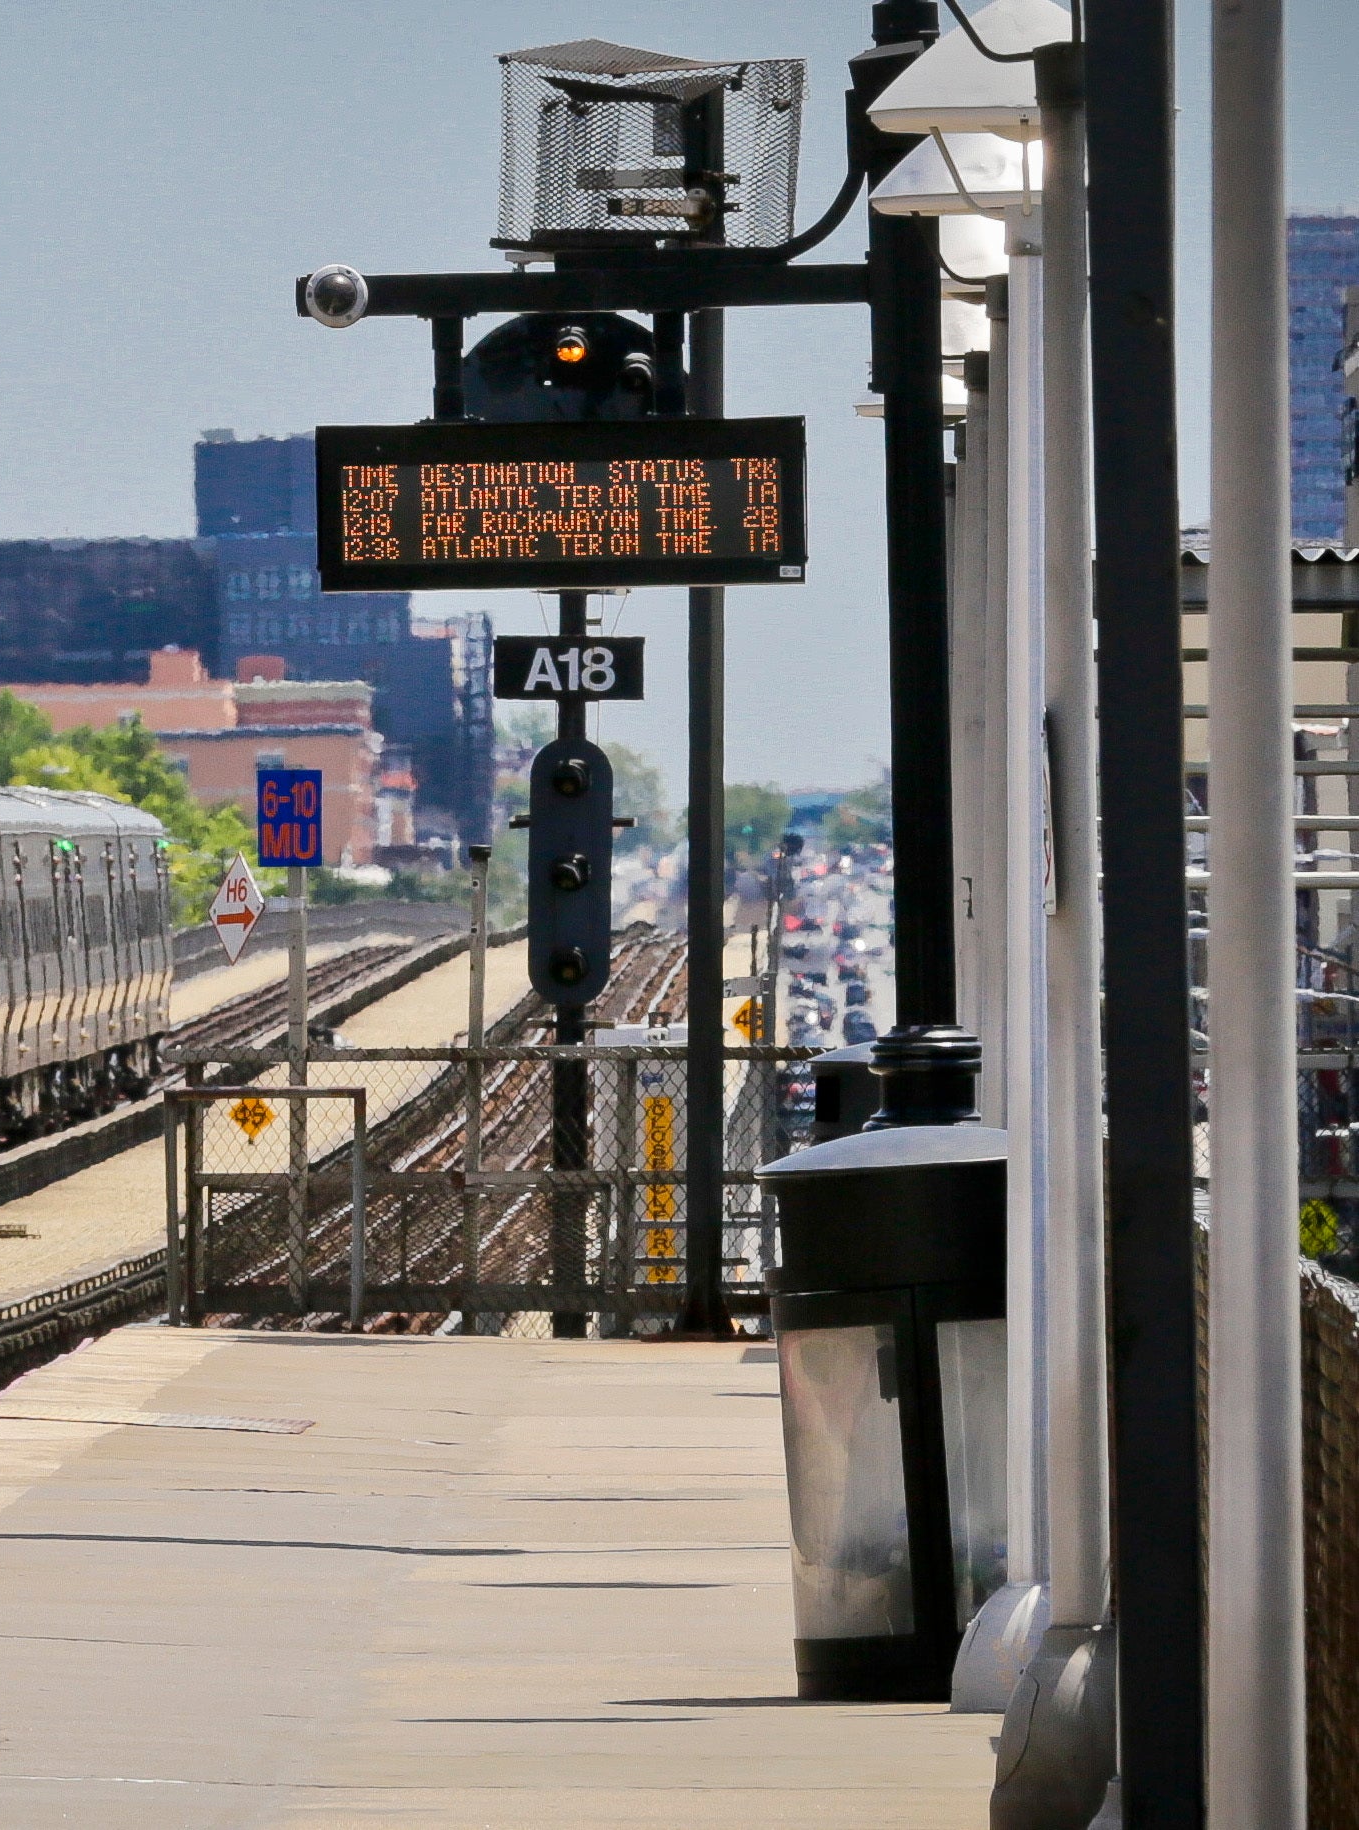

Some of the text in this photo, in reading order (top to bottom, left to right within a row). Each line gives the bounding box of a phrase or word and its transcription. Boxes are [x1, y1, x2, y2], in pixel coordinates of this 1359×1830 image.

[343, 457, 779, 488] TIME DESTINATION STATUS TRK
[343, 481, 778, 512] 12:07 ATLANTIC TER ON TIME 1A
[343, 513, 391, 537] 12:19
[422, 512, 467, 535] FAR
[482, 509, 608, 533] ROCKAWAY
[610, 509, 639, 532] ON
[743, 505, 779, 528] 2B
[344, 529, 779, 561] 12:36 ATLANTIC TER ON TIME 1A
[523, 646, 616, 692] A18
[262, 780, 316, 818] 6-10
[261, 823, 316, 860] MU
[226, 877, 248, 903] H6
